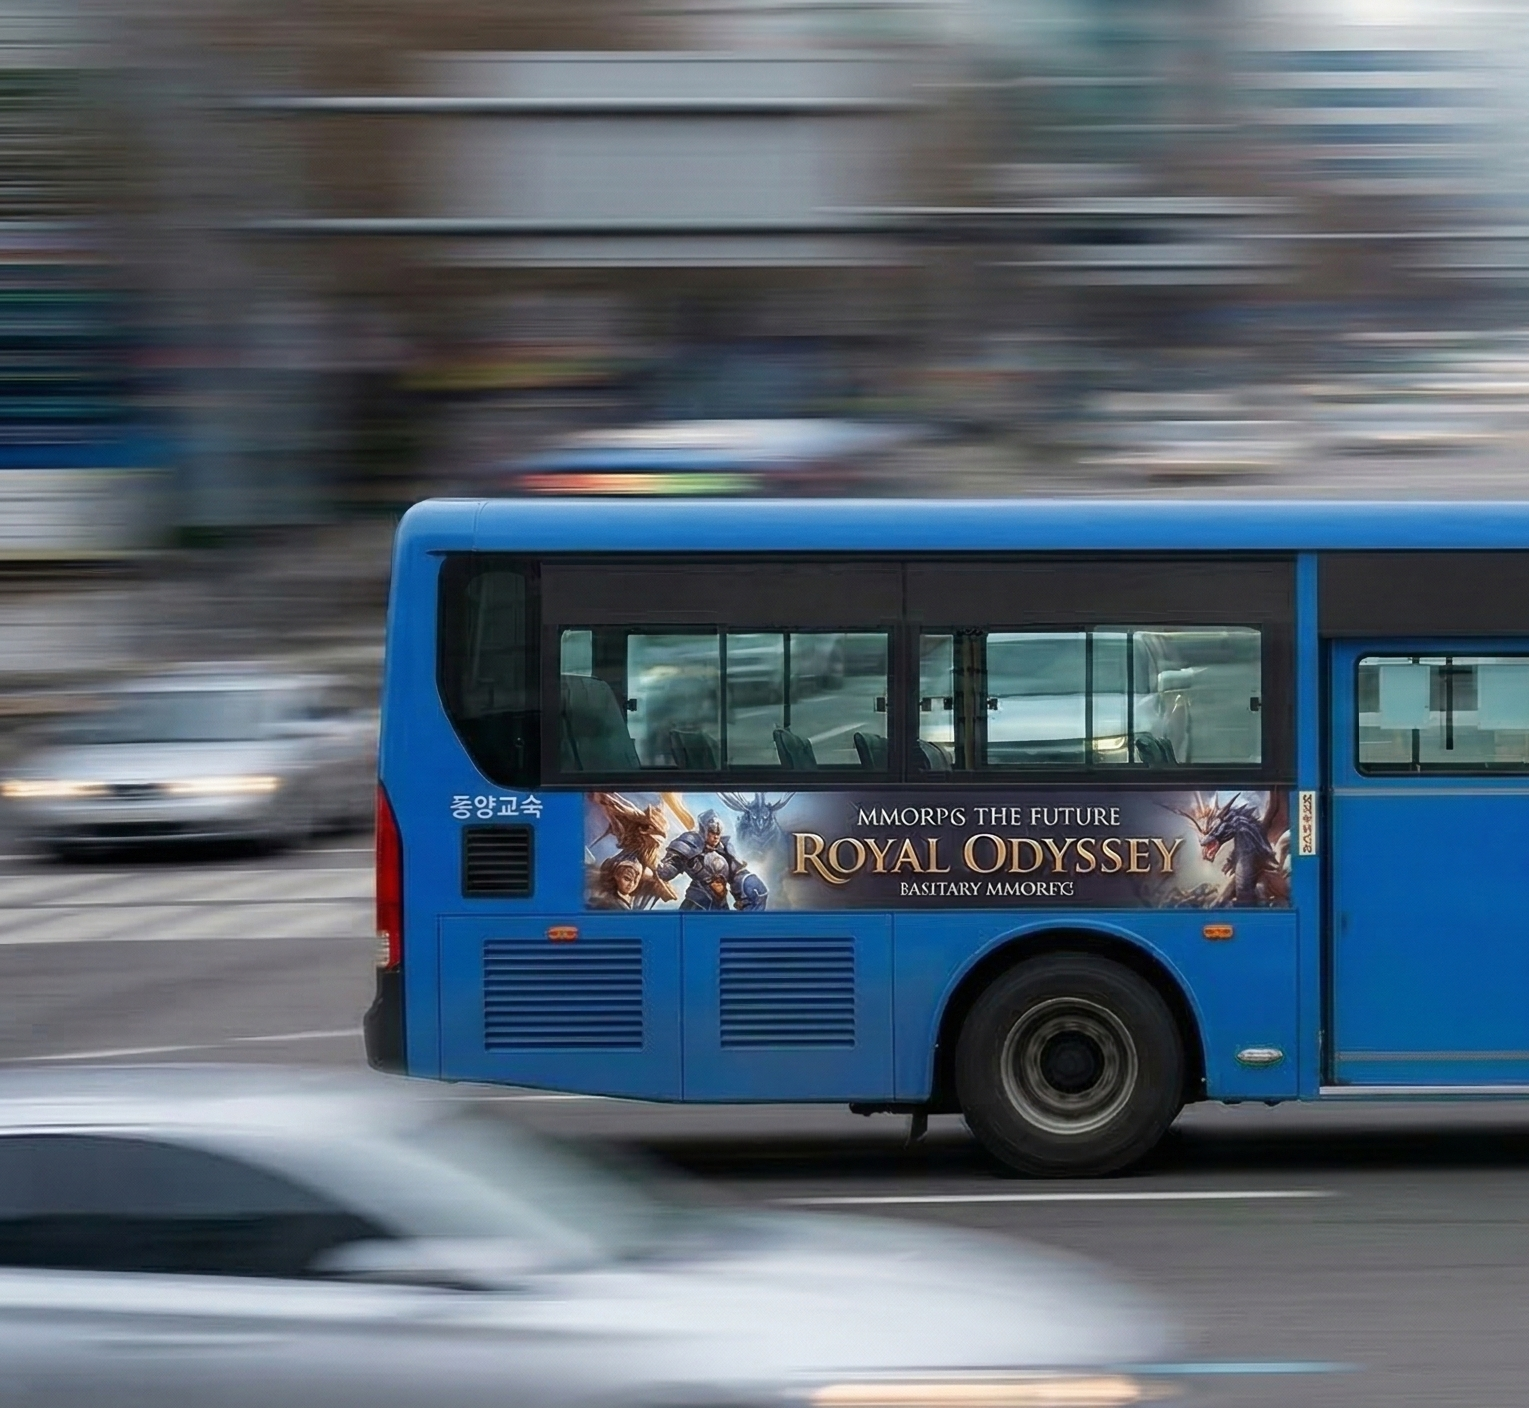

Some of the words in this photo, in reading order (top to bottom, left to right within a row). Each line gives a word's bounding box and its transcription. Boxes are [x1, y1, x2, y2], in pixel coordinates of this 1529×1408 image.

[973, 807, 1021, 826] THE
[1030, 807, 1121, 826] FUTURE
[792, 833, 951, 884] ROYAL
[962, 833, 1184, 874] ODYSSEY
